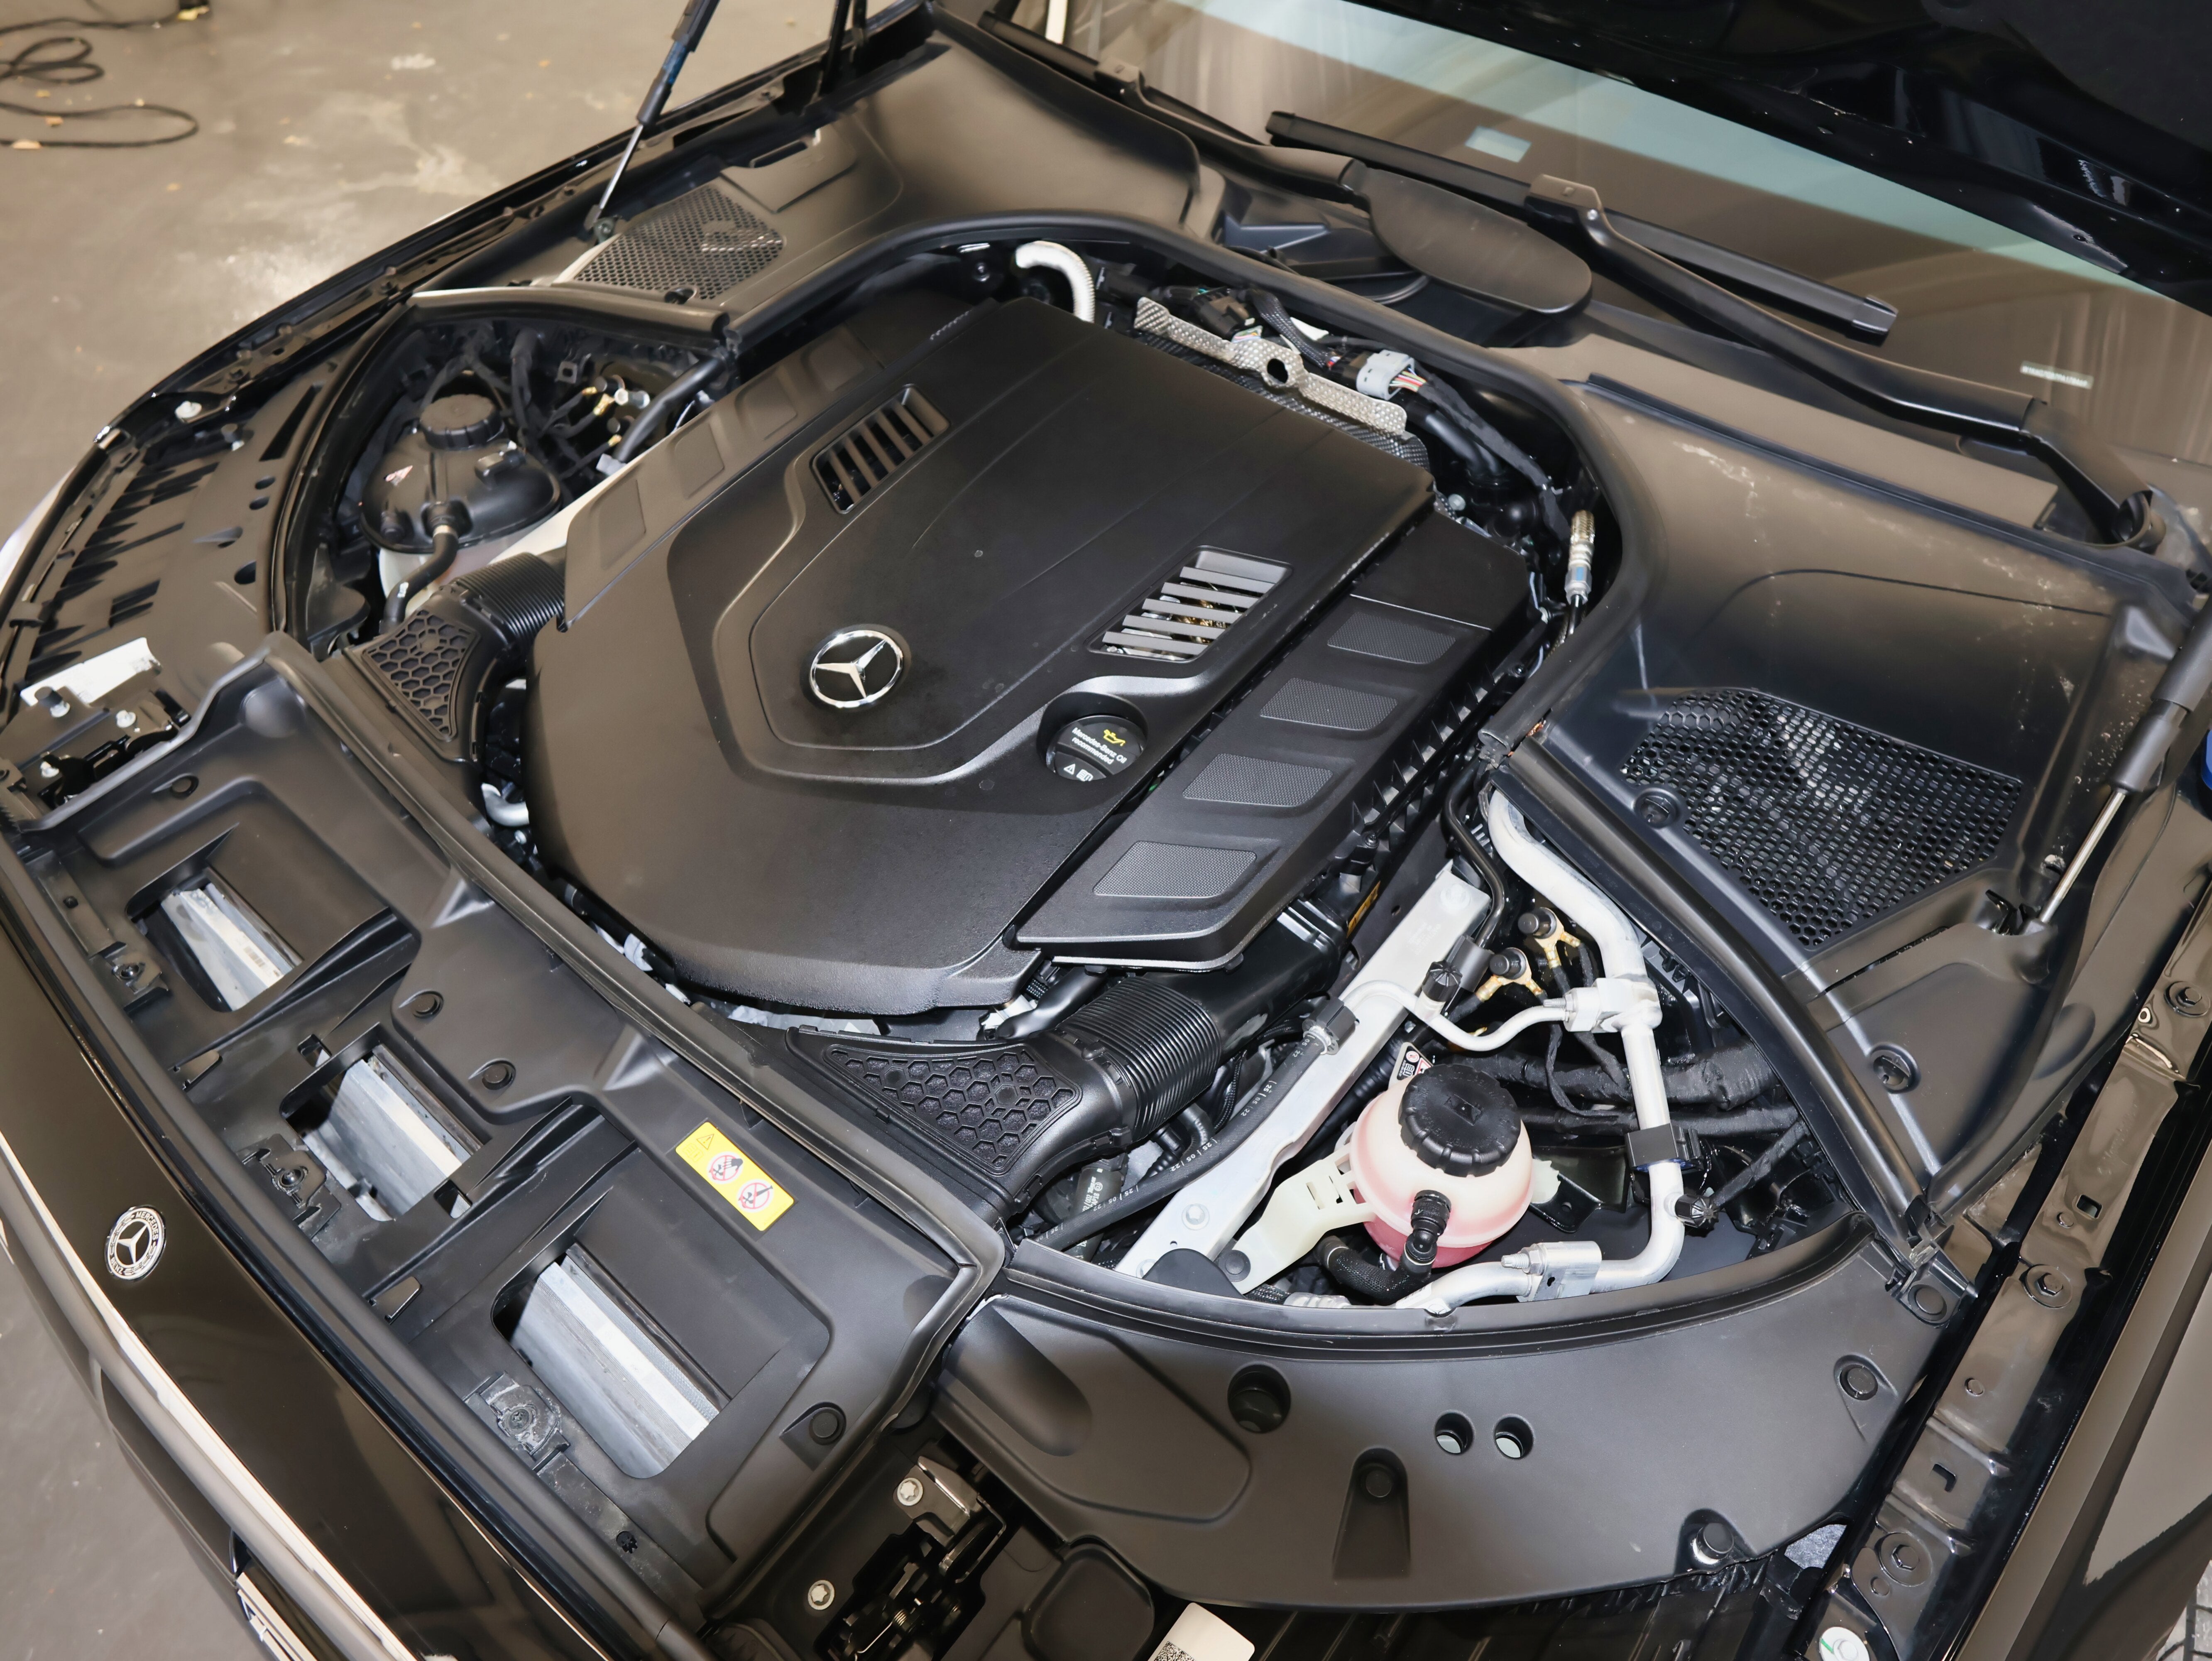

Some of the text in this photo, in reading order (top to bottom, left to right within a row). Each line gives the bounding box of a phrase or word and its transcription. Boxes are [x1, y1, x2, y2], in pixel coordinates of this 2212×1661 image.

[1072, 727, 1127, 764] Mercedes-Benz Oil
[1072, 737, 1114, 765] recommended
[135, 1211, 159, 1240] MERCEDES
[110, 1257, 124, 1274] BENZ
